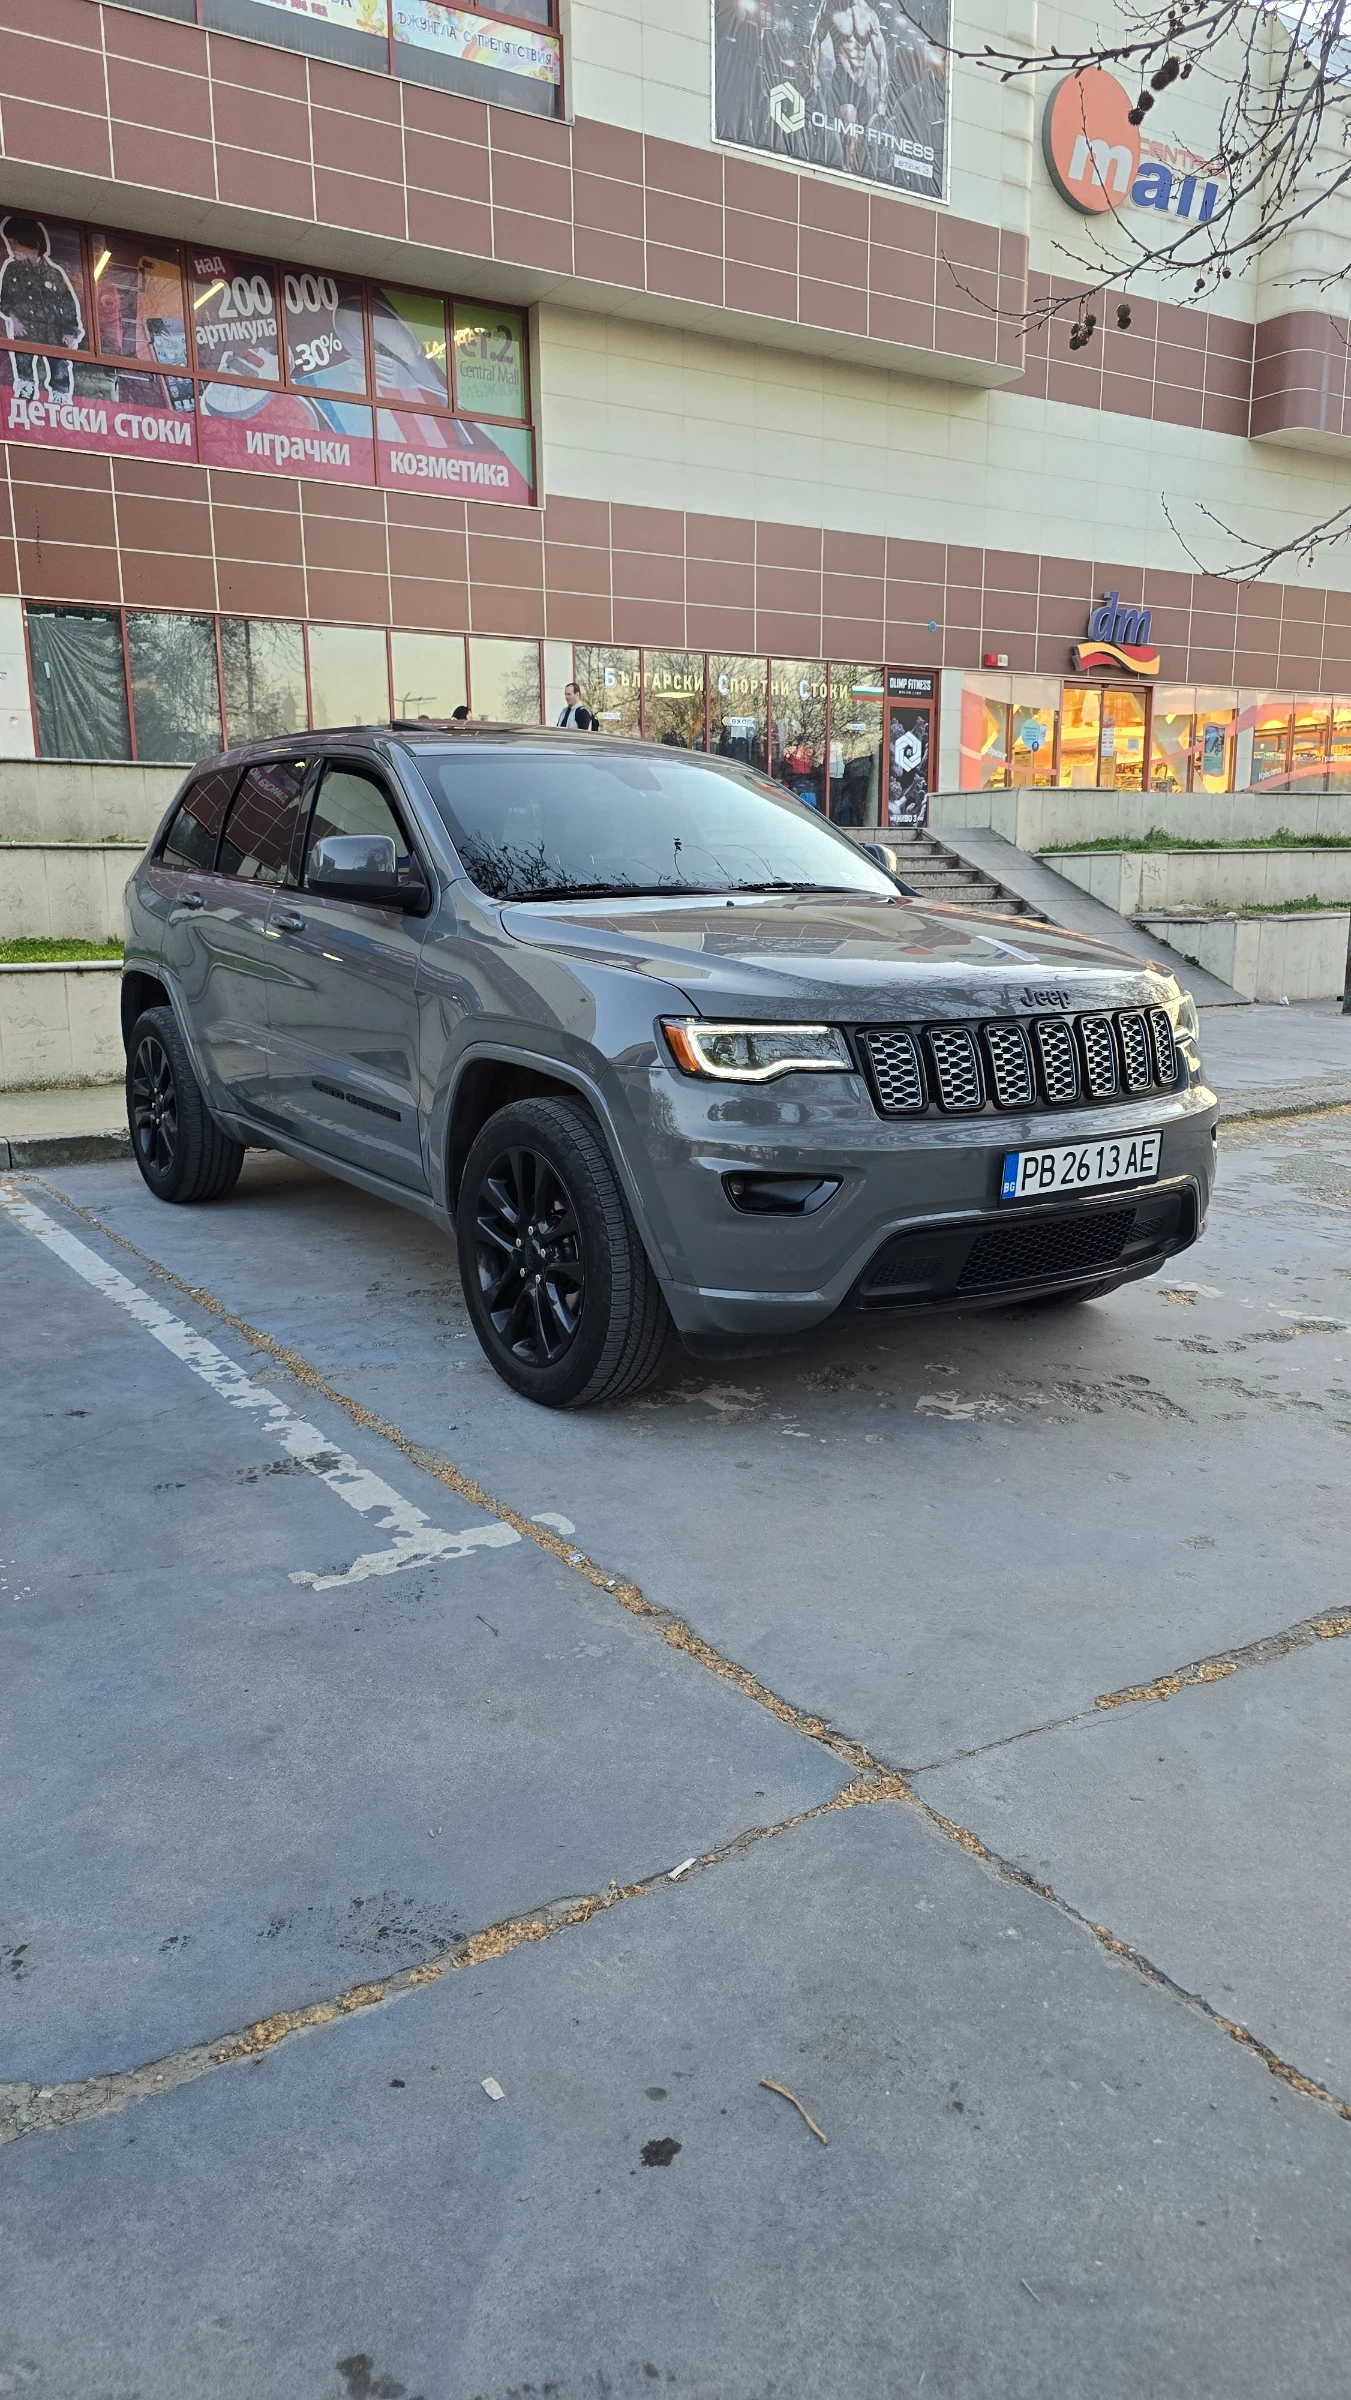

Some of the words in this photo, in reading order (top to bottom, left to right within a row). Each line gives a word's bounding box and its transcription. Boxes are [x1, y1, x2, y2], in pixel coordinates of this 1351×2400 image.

[477, 33, 553, 66] ПРЕПЯТСТВИЯ
[811, 111, 864, 139] OLIMP
[867, 127, 935, 162] FITNESS
[922, 166, 931, 175] 3
[1068, 134, 1219, 223] mall
[193, 255, 227, 276] над
[210, 274, 273, 319] 200
[284, 273, 339, 315] 000
[195, 317, 278, 350] артикула
[294, 332, 343, 372] -30%
[460, 360, 495, 382] Central
[497, 364, 520, 386] Mall
[8, 397, 109, 435] детски
[114, 412, 192, 447] стоки
[246, 430, 351, 467] играчки
[390, 450, 510, 488] козметика
[1088, 591, 1152, 645] dm
[889, 677, 908, 689] OLIMP
[907, 678, 932, 691] FITNESS
[913, 814, 918, 823] 3
[1020, 987, 1070, 1009] Jeep
[1021, 1154, 1056, 1191] PB
[1060, 1144, 1121, 1185] 2613
[1125, 1139, 1156, 1175] AE
[1003, 1181, 1016, 1194] BG
